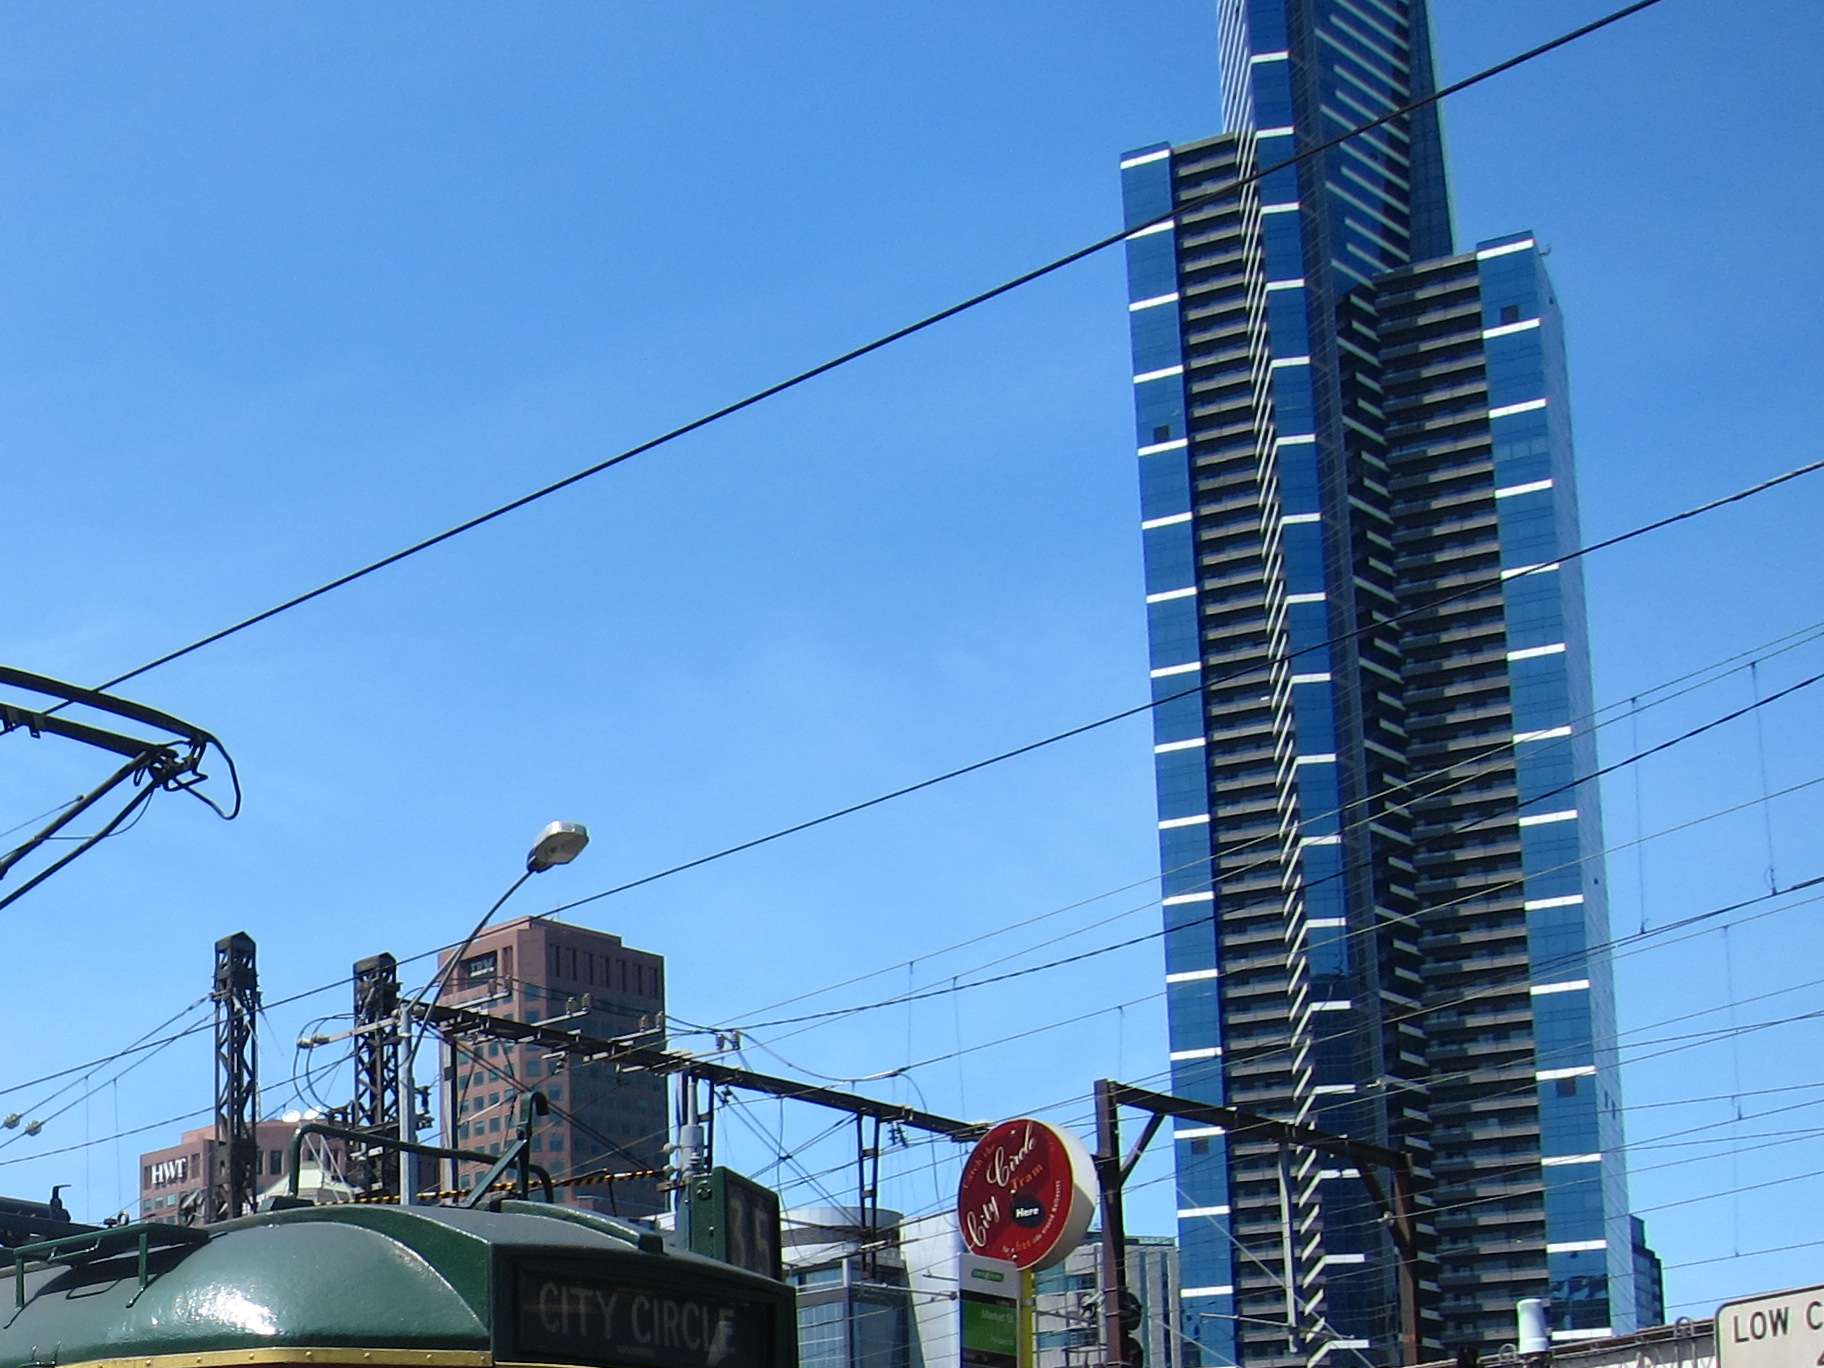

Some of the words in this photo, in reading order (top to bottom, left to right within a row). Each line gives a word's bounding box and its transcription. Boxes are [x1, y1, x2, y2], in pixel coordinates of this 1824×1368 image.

[151, 1158, 187, 1185] HWT
[967, 1196, 1000, 1247] City
[986, 1121, 1033, 1187] Circle
[1015, 1207, 1040, 1219] Here
[538, 1282, 617, 1340] CITY
[631, 1296, 736, 1354] CIRCLE
[1733, 1307, 1789, 1343] LOW
